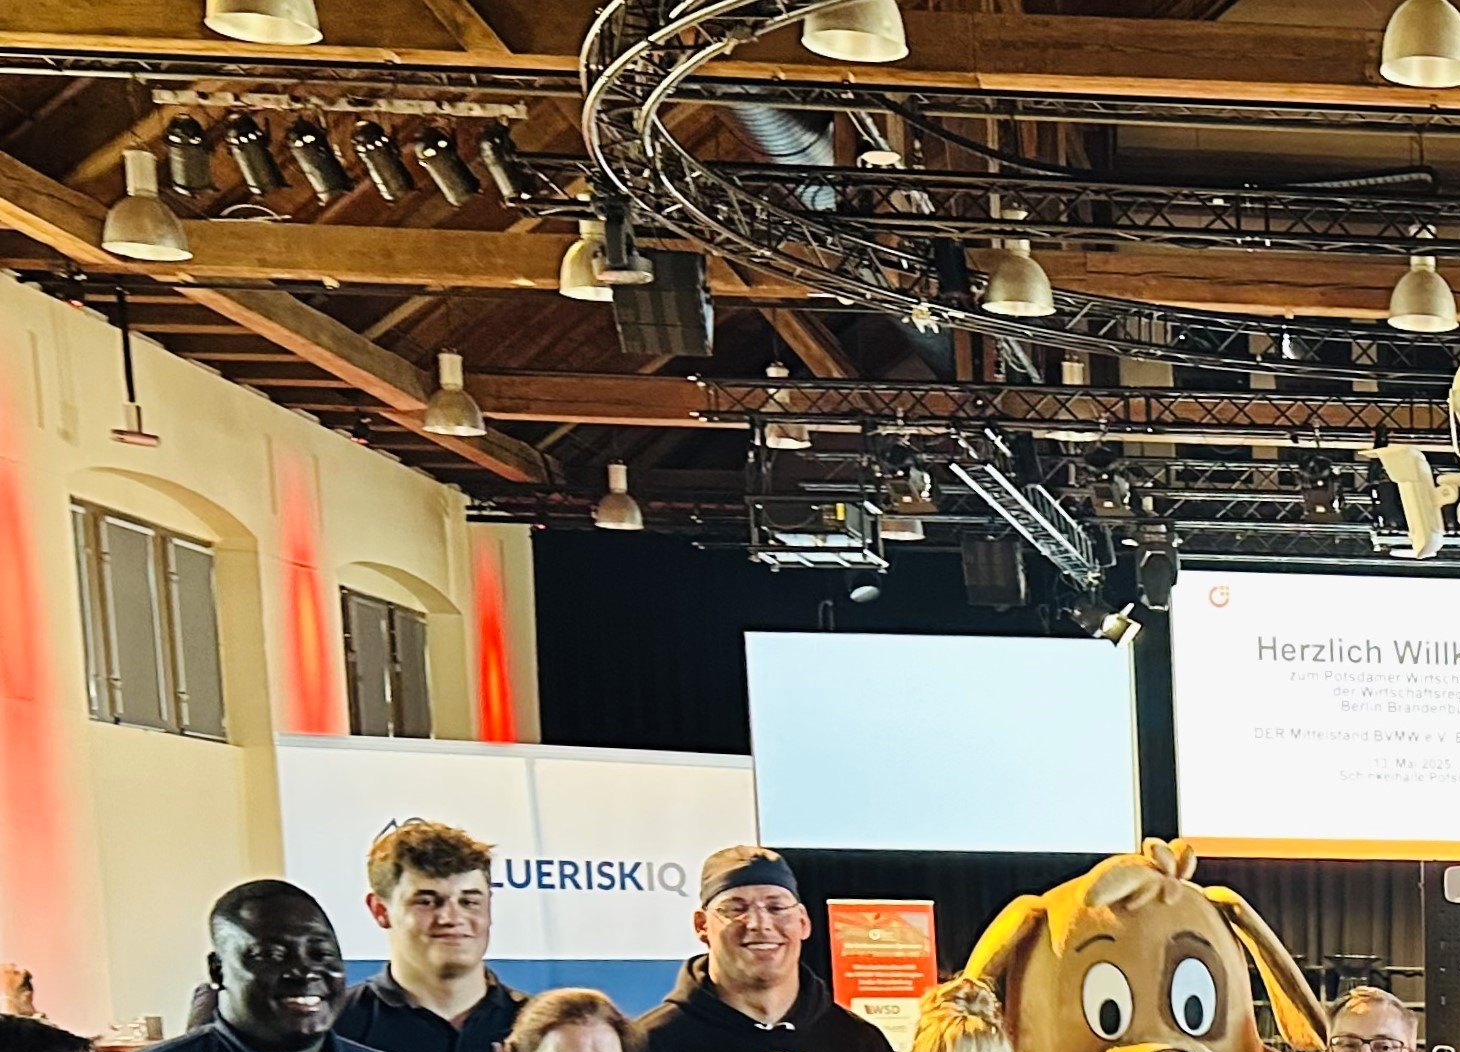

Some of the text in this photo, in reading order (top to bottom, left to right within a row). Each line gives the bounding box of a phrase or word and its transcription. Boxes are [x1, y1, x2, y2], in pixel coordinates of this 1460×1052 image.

[1257, 636, 1382, 663] Herzlich
[1289, 671, 1319, 682] zum
[1324, 670, 1401, 683] Potsdamer
[1333, 685, 1356, 697] der
[1341, 700, 1382, 713] Berlin
[1254, 727, 1285, 739] DER
[1290, 727, 1369, 741] Mittelstand
[1374, 730, 1420, 742] BVMW
[1422, 758, 1452, 770] 2025
[872, 1004, 901, 1015] WSD
